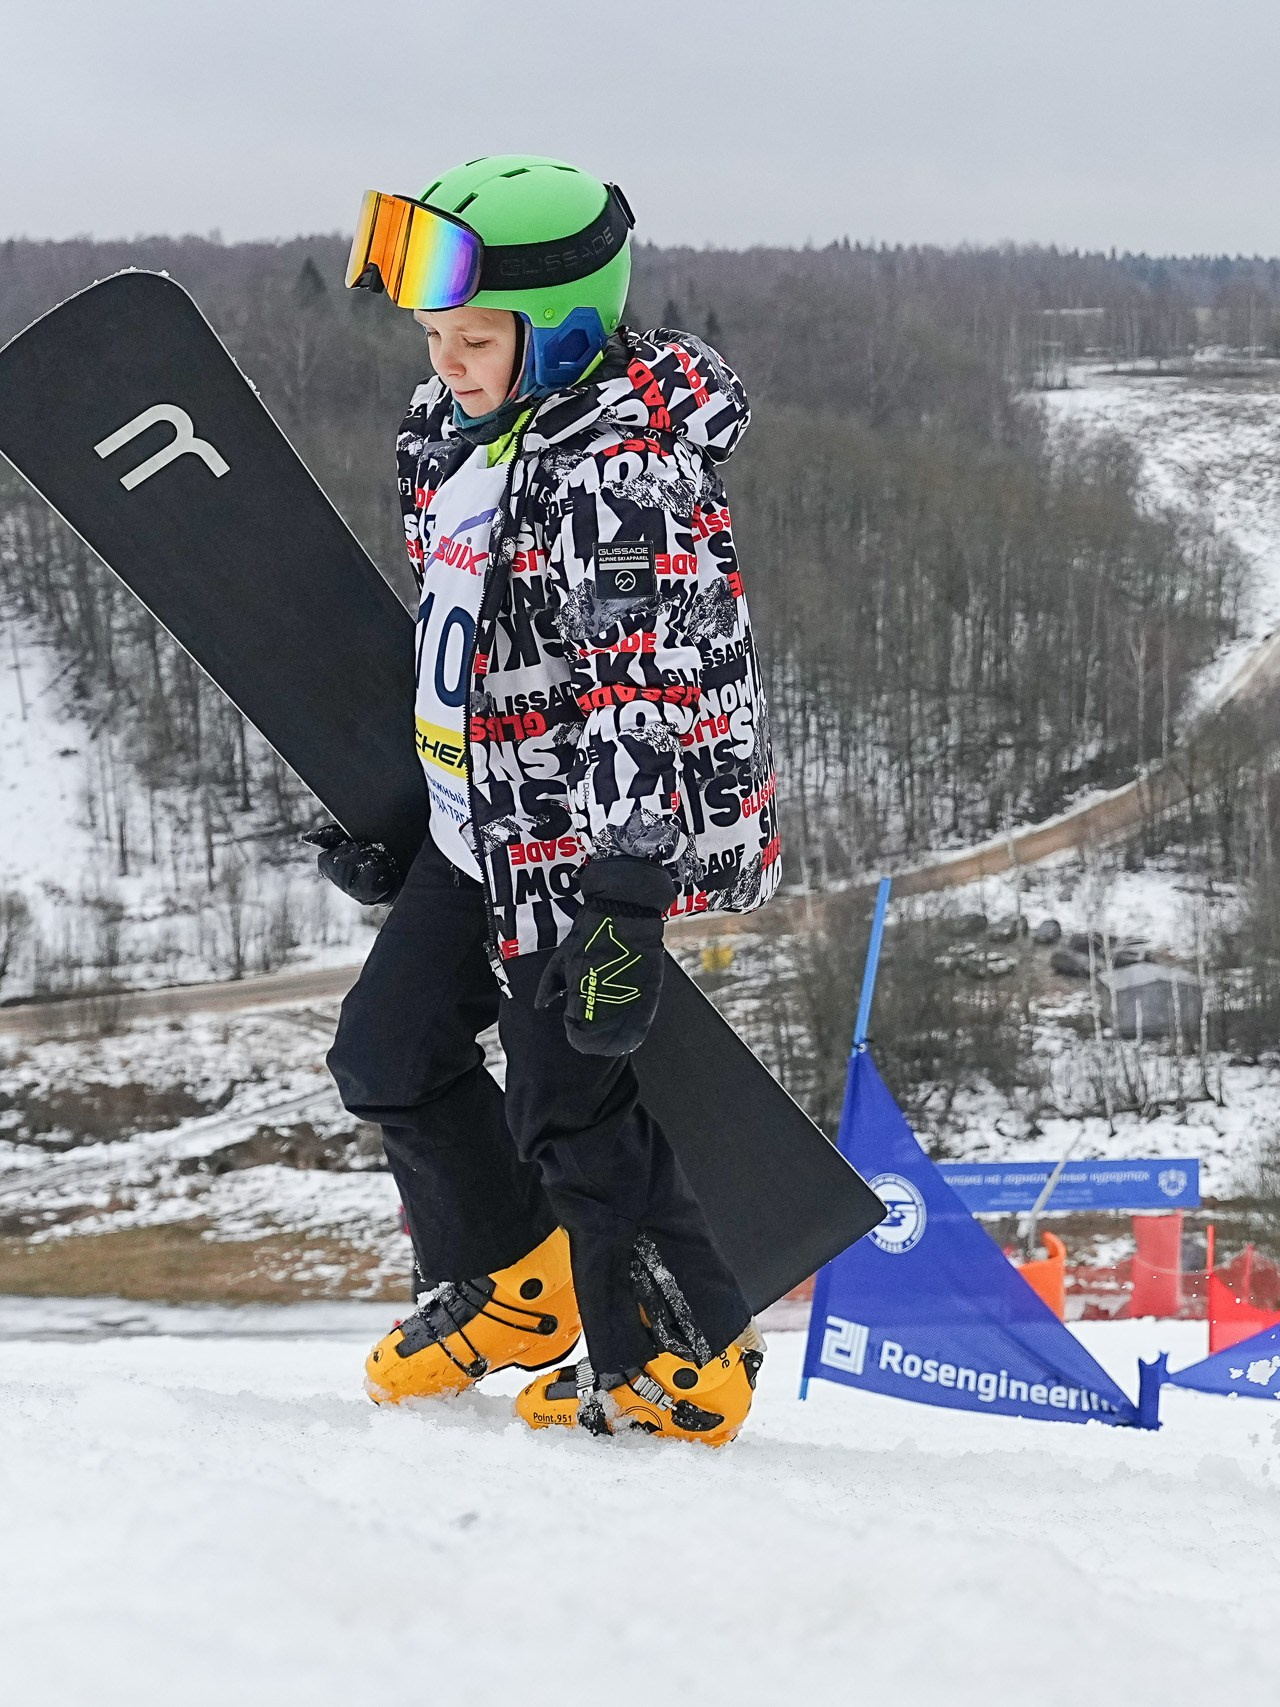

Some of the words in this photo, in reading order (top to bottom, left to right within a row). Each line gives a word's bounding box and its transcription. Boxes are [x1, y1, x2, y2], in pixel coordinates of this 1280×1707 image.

[500, 226, 615, 276] GLISSADE
[598, 547, 649, 556] GLISSADE
[492, 681, 573, 717] LISSAD
[584, 967, 598, 1021] ziener
[533, 1412, 572, 1423] Point.951
